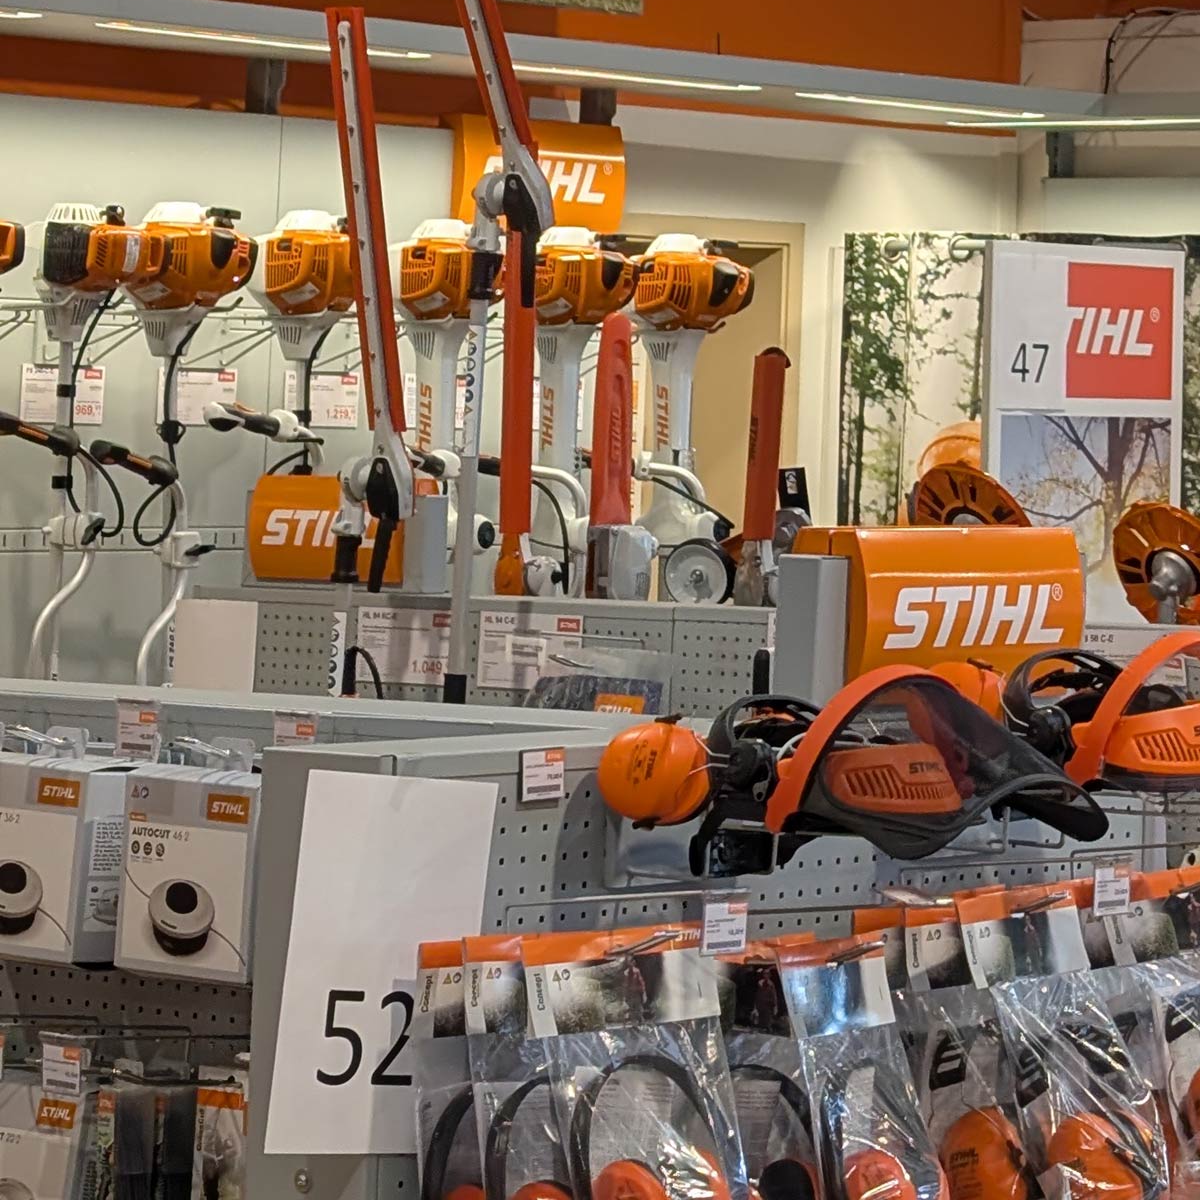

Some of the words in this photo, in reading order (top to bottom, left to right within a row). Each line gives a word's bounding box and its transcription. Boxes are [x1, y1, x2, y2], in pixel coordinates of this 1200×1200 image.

[1011, 343, 1049, 383] 47
[418, 384, 432, 451] STIHL
[540, 385, 554, 448] STIHL
[656, 384, 669, 452] STIHL
[882, 583, 1064, 650] STIHL
[41, 784, 76, 799] STIHL
[211, 801, 245, 816] STIHL
[132, 826, 170, 840] AUTOCUT
[677, 928, 701, 942] STIH
[421, 975, 433, 1014] Concept
[469, 968, 479, 1008] Concept
[537, 972, 546, 1012] Concept
[317, 990, 415, 1086] 52
[41, 1106, 71, 1121] STIHL
